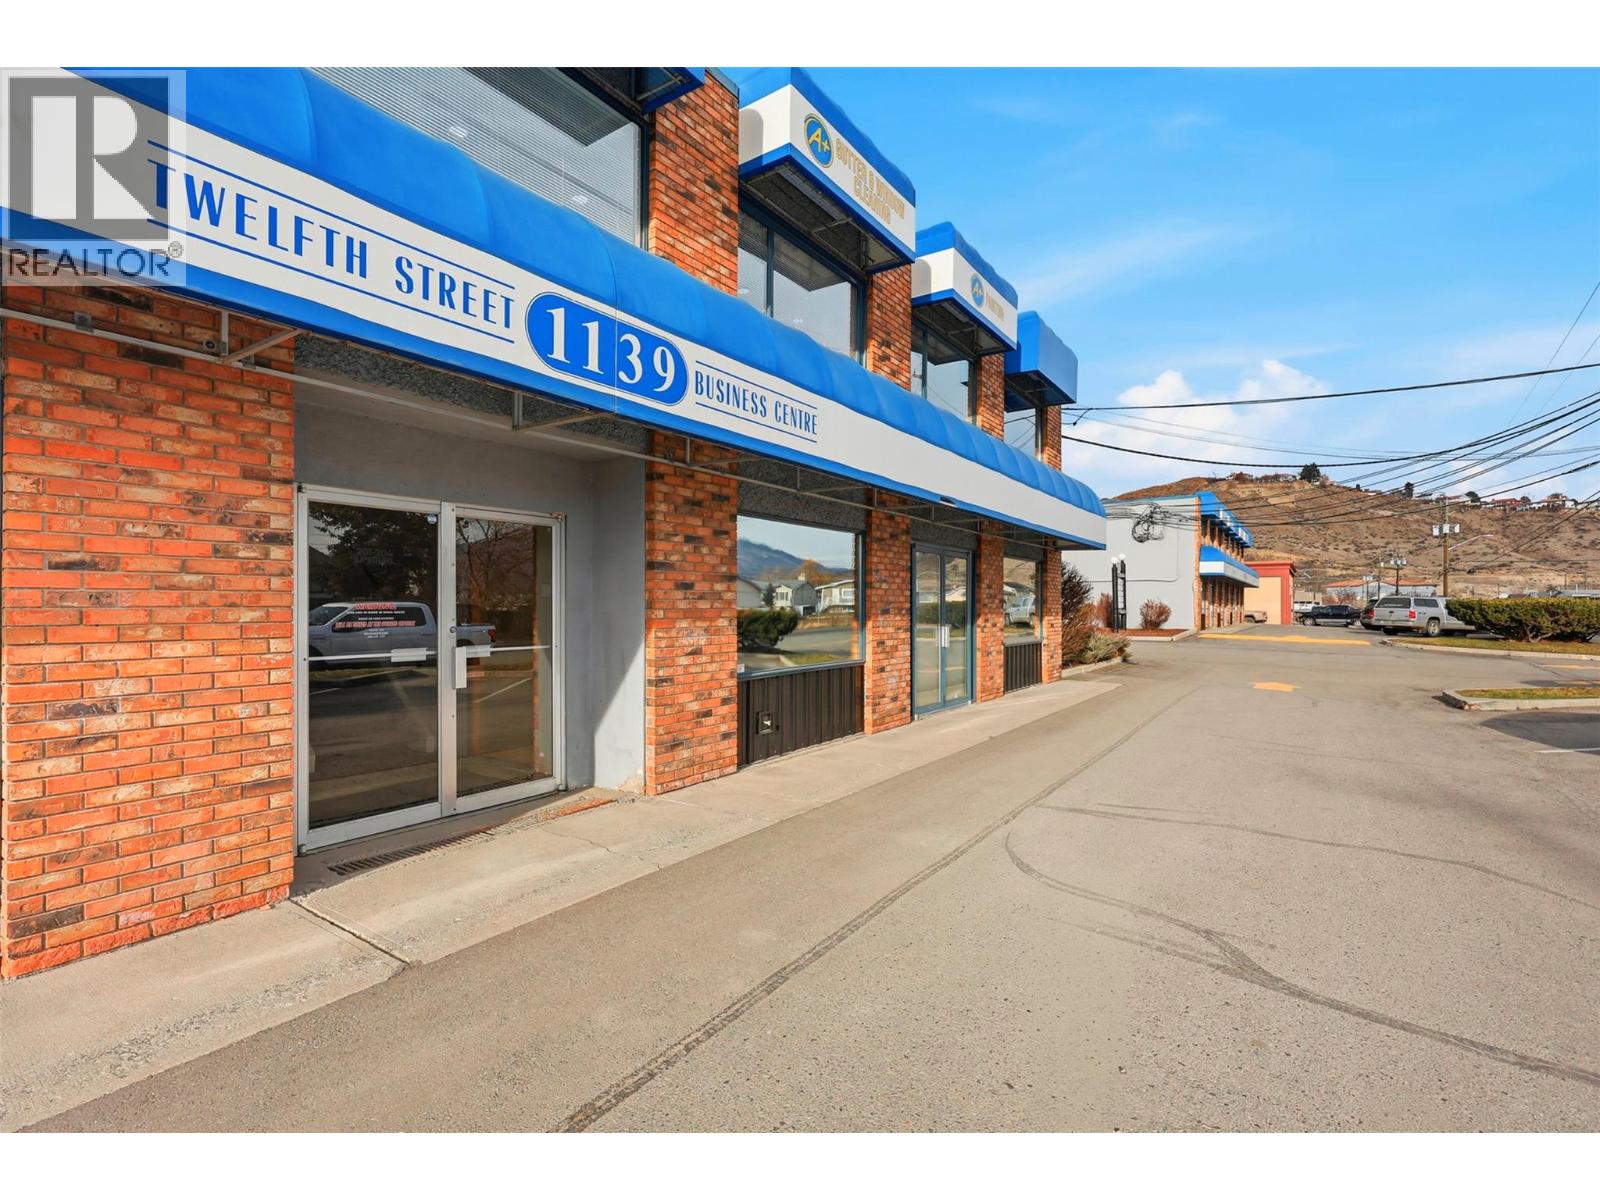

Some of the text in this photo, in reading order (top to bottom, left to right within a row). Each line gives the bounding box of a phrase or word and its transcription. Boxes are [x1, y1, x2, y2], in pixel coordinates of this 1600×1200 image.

[808, 128, 830, 152] A+
[147, 159, 515, 329] TWELFTH STREET
[546, 307, 675, 392] 1139
[695, 371, 818, 435] BUSINESS CENTRE
